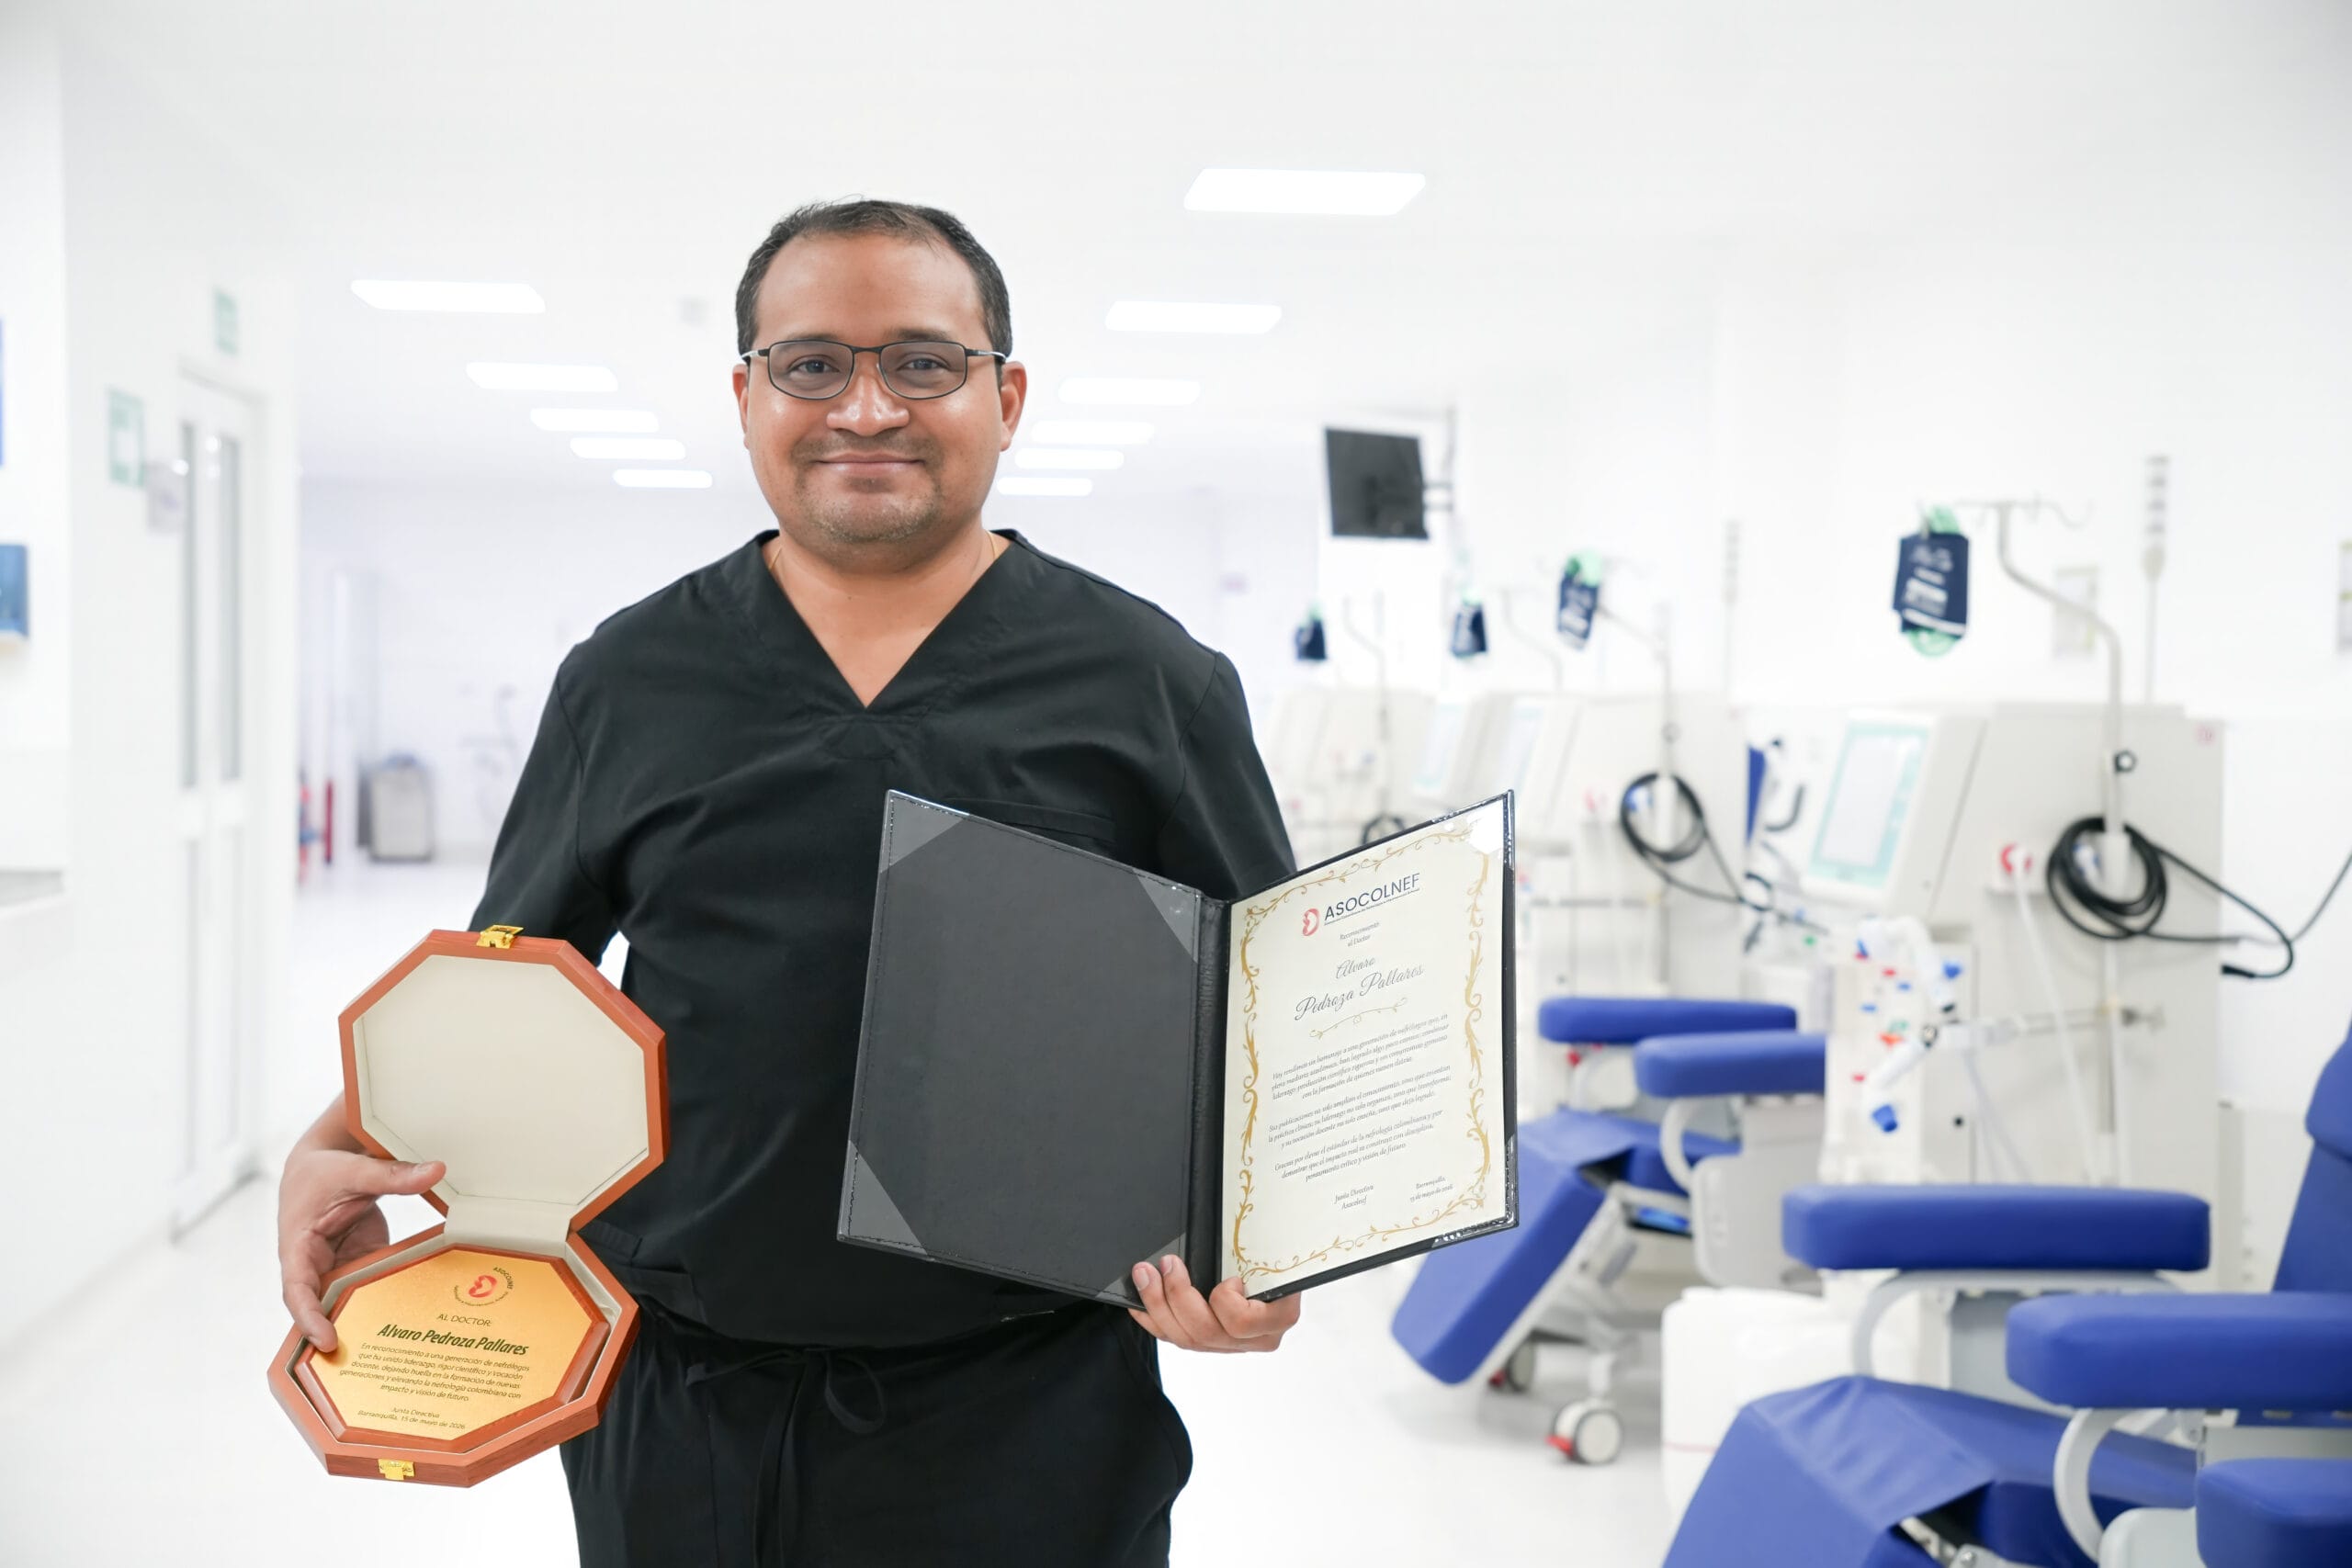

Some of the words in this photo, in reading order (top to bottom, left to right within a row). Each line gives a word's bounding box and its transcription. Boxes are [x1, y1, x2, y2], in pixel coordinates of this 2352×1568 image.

[1324, 873, 1419, 920] ASOCOLNEF
[1294, 990, 1353, 1021] Pedroza
[1359, 965, 1423, 997] Pallares
[377, 1324, 422, 1340] Alvaro
[421, 1329, 475, 1348] Pedroza
[474, 1337, 529, 1355] Pallares
[371, 1346, 424, 1357] reconocimiento
[381, 1364, 410, 1374] dejando
[410, 1368, 431, 1377] huella
[339, 1370, 385, 1380] generaciones
[390, 1376, 423, 1385] elevando
[467, 1387, 507, 1397] colombiana
[380, 1384, 409, 1393] impacto
[411, 1409, 439, 1418] Directiva
